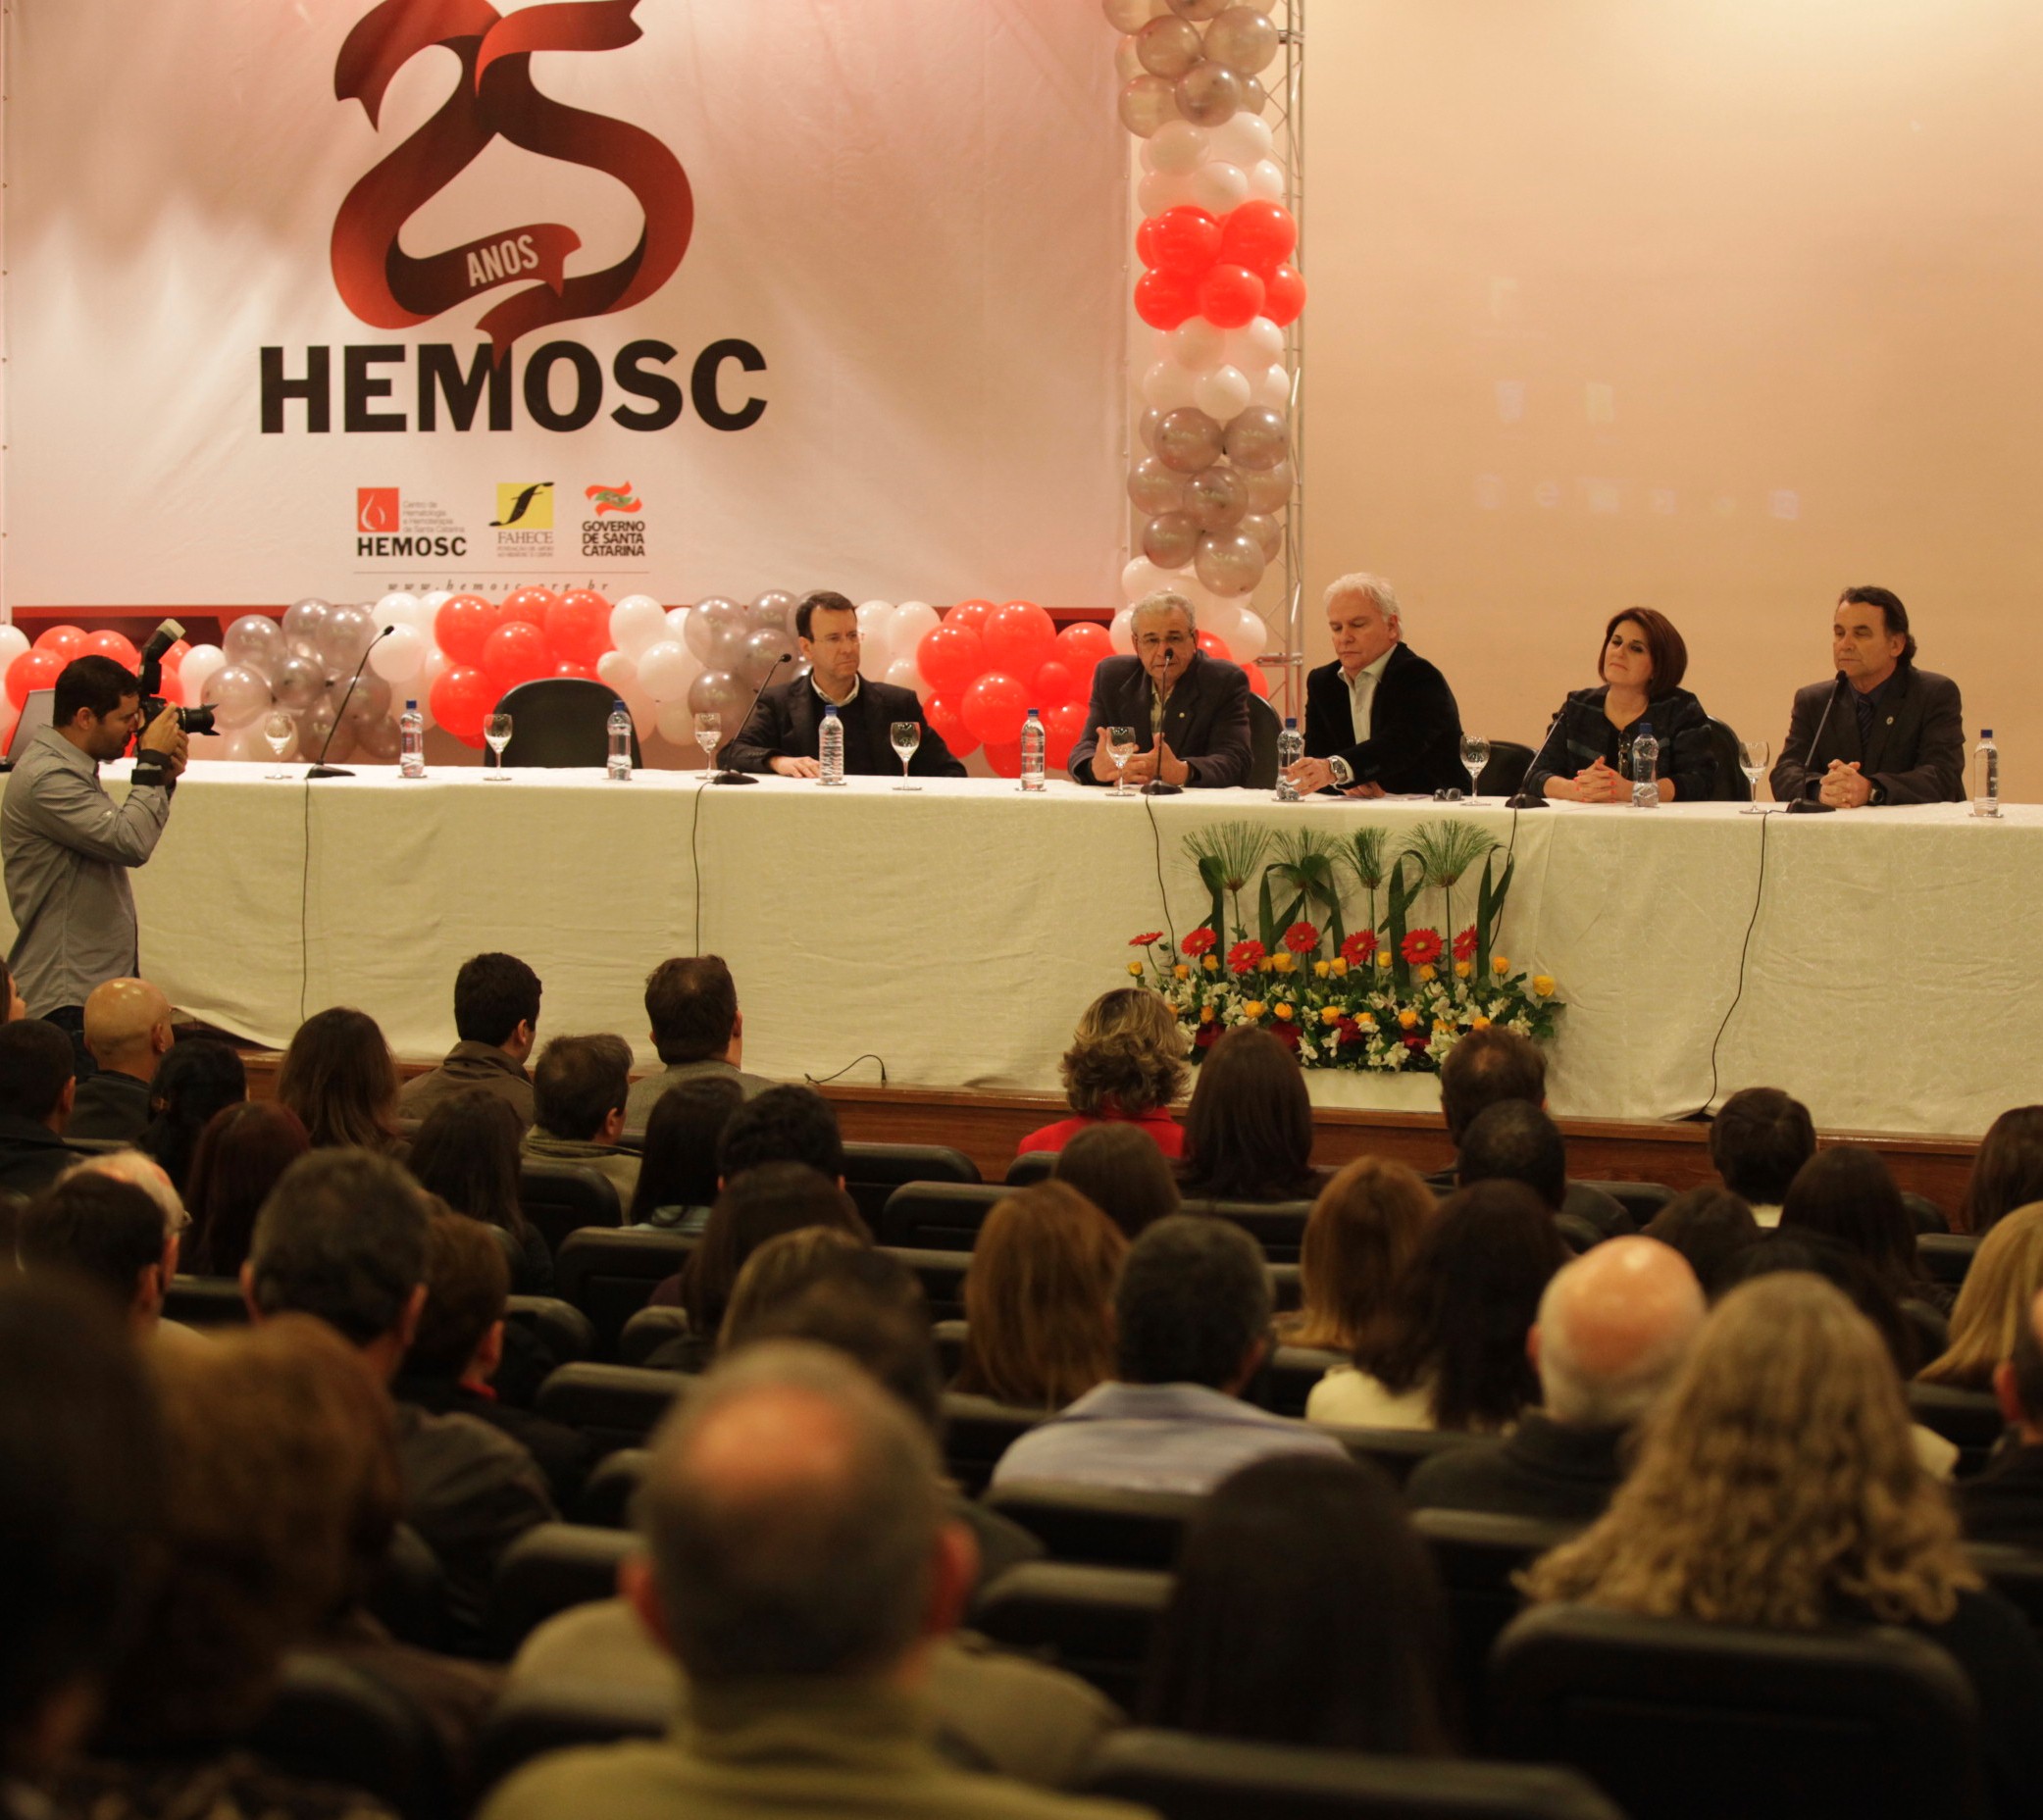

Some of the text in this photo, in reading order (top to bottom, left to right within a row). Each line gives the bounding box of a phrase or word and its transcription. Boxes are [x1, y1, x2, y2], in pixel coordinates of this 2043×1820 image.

[466, 234, 539, 287] ANOS
[260, 338, 768, 434] HEMOSC
[582, 521, 646, 532] GOVERNO
[497, 531, 554, 544] FAHECE
[583, 532, 645, 544] DE SANTA
[357, 536, 467, 557] HEMOSC
[582, 544, 646, 557] CATARINA
[387, 579, 608, 592] www.hemoscorg.br
